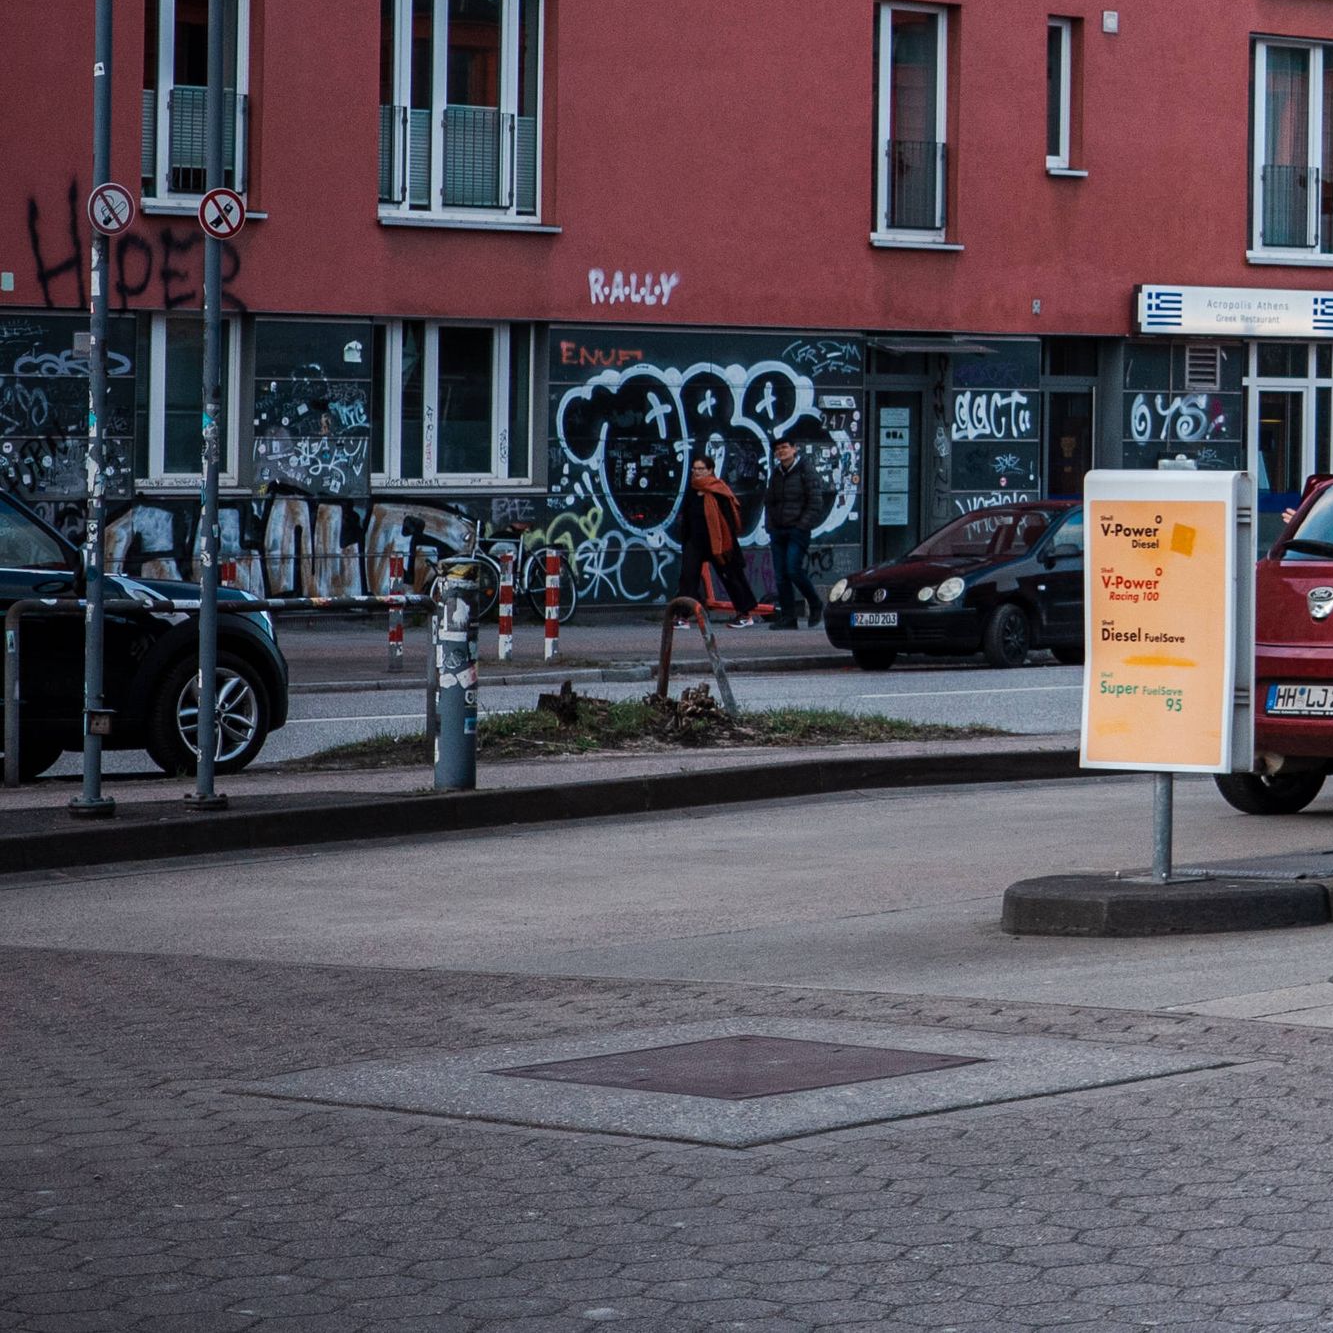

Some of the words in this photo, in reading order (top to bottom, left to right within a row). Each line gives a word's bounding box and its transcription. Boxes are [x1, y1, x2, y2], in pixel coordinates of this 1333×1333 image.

[1206, 299, 1252, 312] Acropolis
[1256, 301, 1290, 312] Athens
[1216, 313, 1237, 324] Greek
[1240, 314, 1281, 325] Restaurant
[1101, 523, 1159, 538] V-Power
[1131, 539, 1159, 549] Diesel
[1101, 575, 1159, 590] V-Power
[1109, 591, 1139, 603] Racing
[1142, 591, 1159, 601] 100
[881, 615, 897, 625] 203
[1101, 628, 1142, 642] Diesel
[1145, 632, 1185, 643] FuelSave
[1100, 681, 1139, 697] Super
[1142, 684, 1183, 696] FuelSave
[1166, 698, 1183, 712] 95
[1276, 688, 1298, 708] HH
[1306, 688, 1328, 708] LJ
